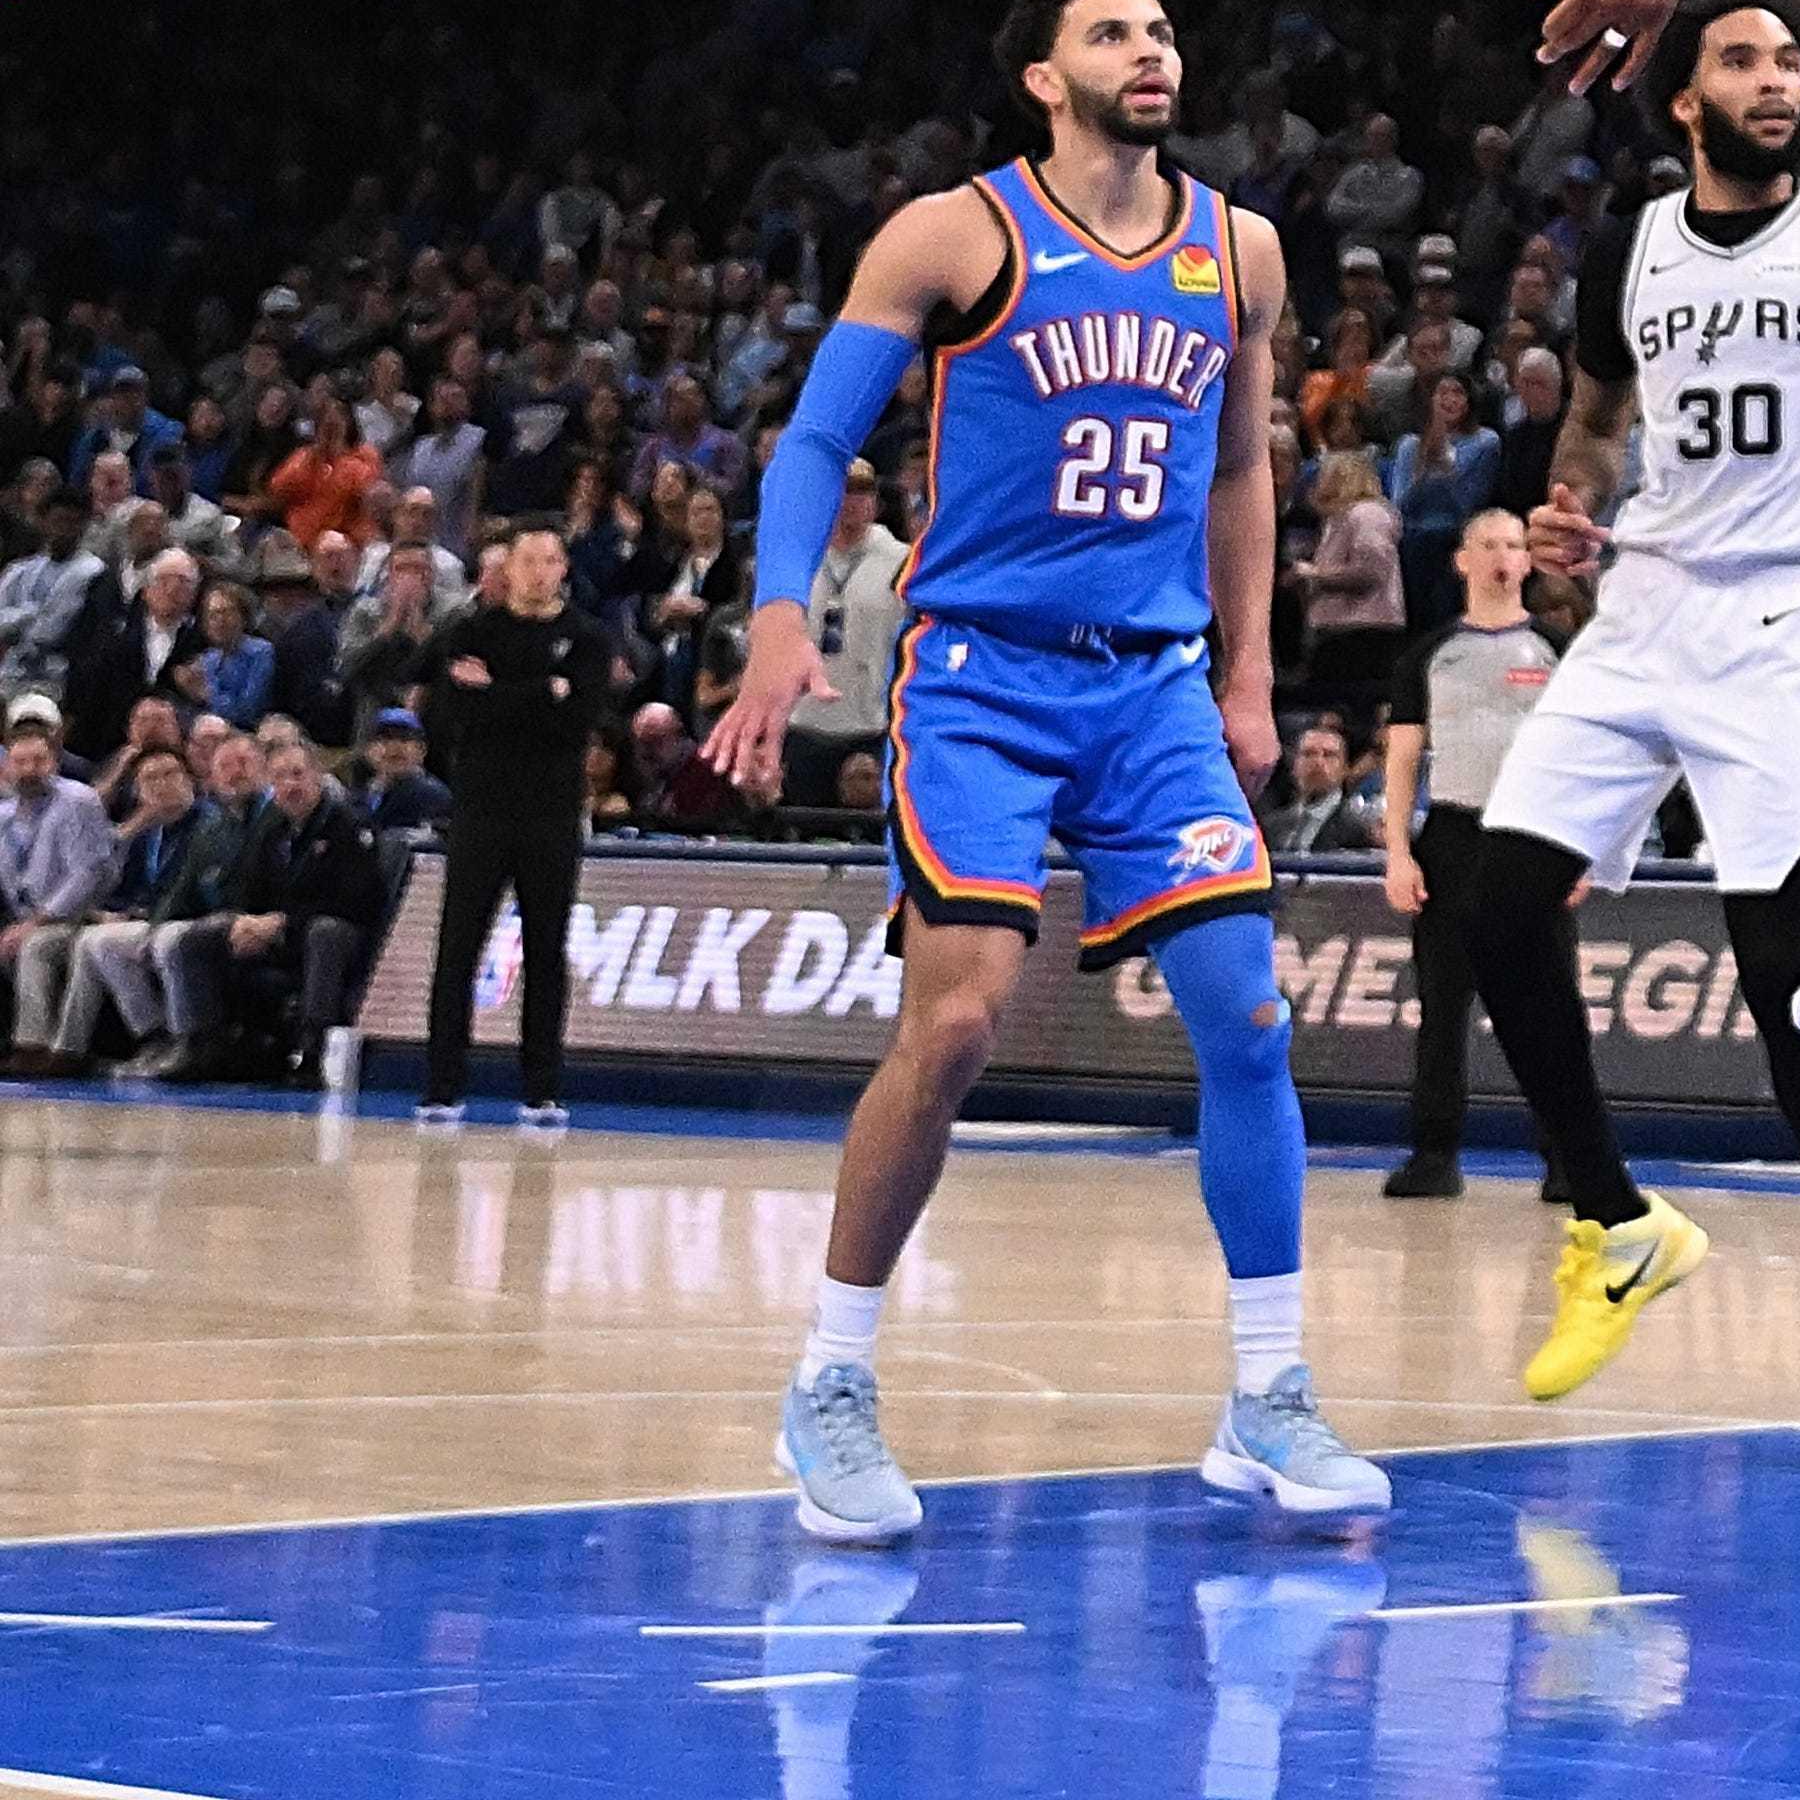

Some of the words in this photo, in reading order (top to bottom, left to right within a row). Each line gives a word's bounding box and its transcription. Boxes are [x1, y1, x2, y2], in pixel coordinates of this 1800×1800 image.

[1010, 312, 1233, 412] THUNDER
[1054, 413, 1172, 522] 25
[1676, 382, 1786, 463] 30
[566, 903, 772, 1014] MLK
[757, 908, 906, 1019] DA
